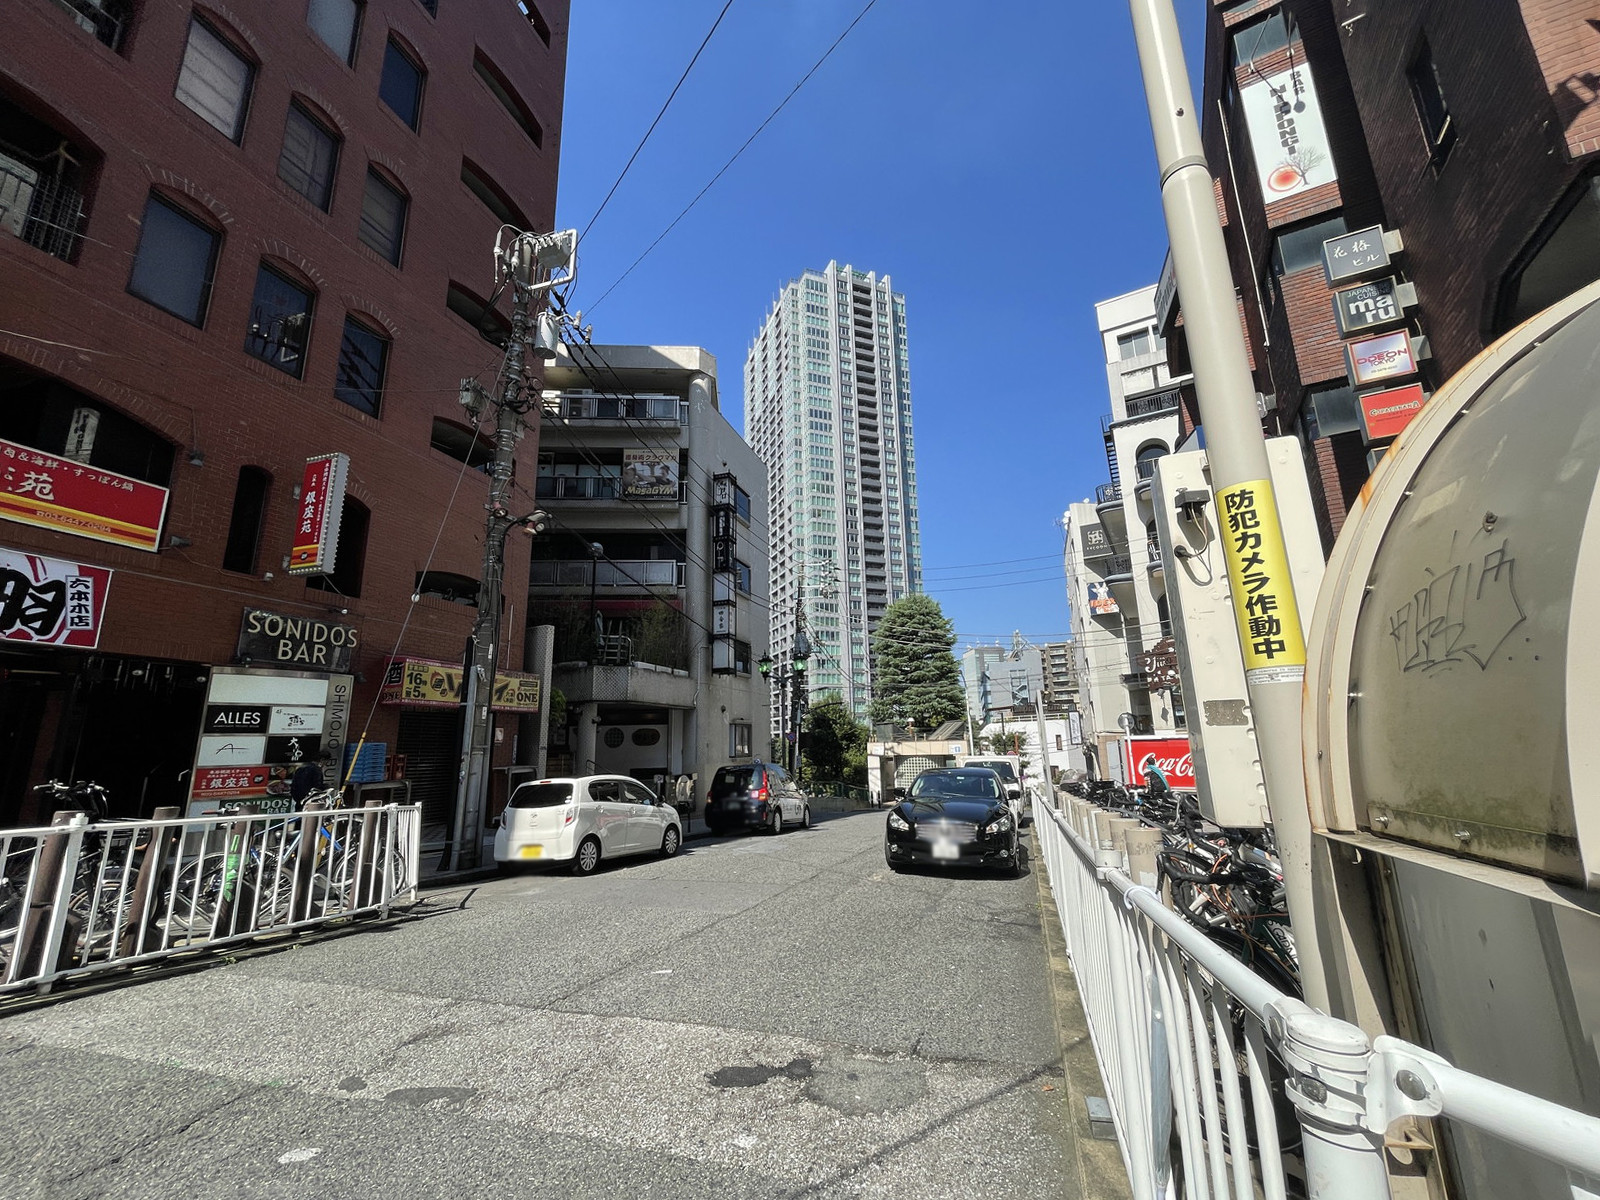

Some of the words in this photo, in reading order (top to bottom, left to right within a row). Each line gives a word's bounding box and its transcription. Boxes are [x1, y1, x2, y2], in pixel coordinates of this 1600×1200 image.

[1356, 348, 1408, 365] ODEON
[1370, 357, 1396, 367] TOKYO
[0, 446, 134, 492] 肉&海鮮・すっぽん鍋
[300, 491, 316, 534] 銀座苑
[1224, 488, 1286, 660] 防犯カメラ作動中
[69, 578, 91, 627] 六本木店
[247, 612, 358, 648] SONIDOS
[277, 639, 327, 665] BAR
[516, 692, 538, 703] ONE
[214, 711, 261, 725] ALLES
[328, 684, 346, 750] SHIMOJO
[1138, 752, 1196, 777] Cca-C
[209, 777, 249, 789] 銀座苑
[224, 798, 290, 811] SODOS
